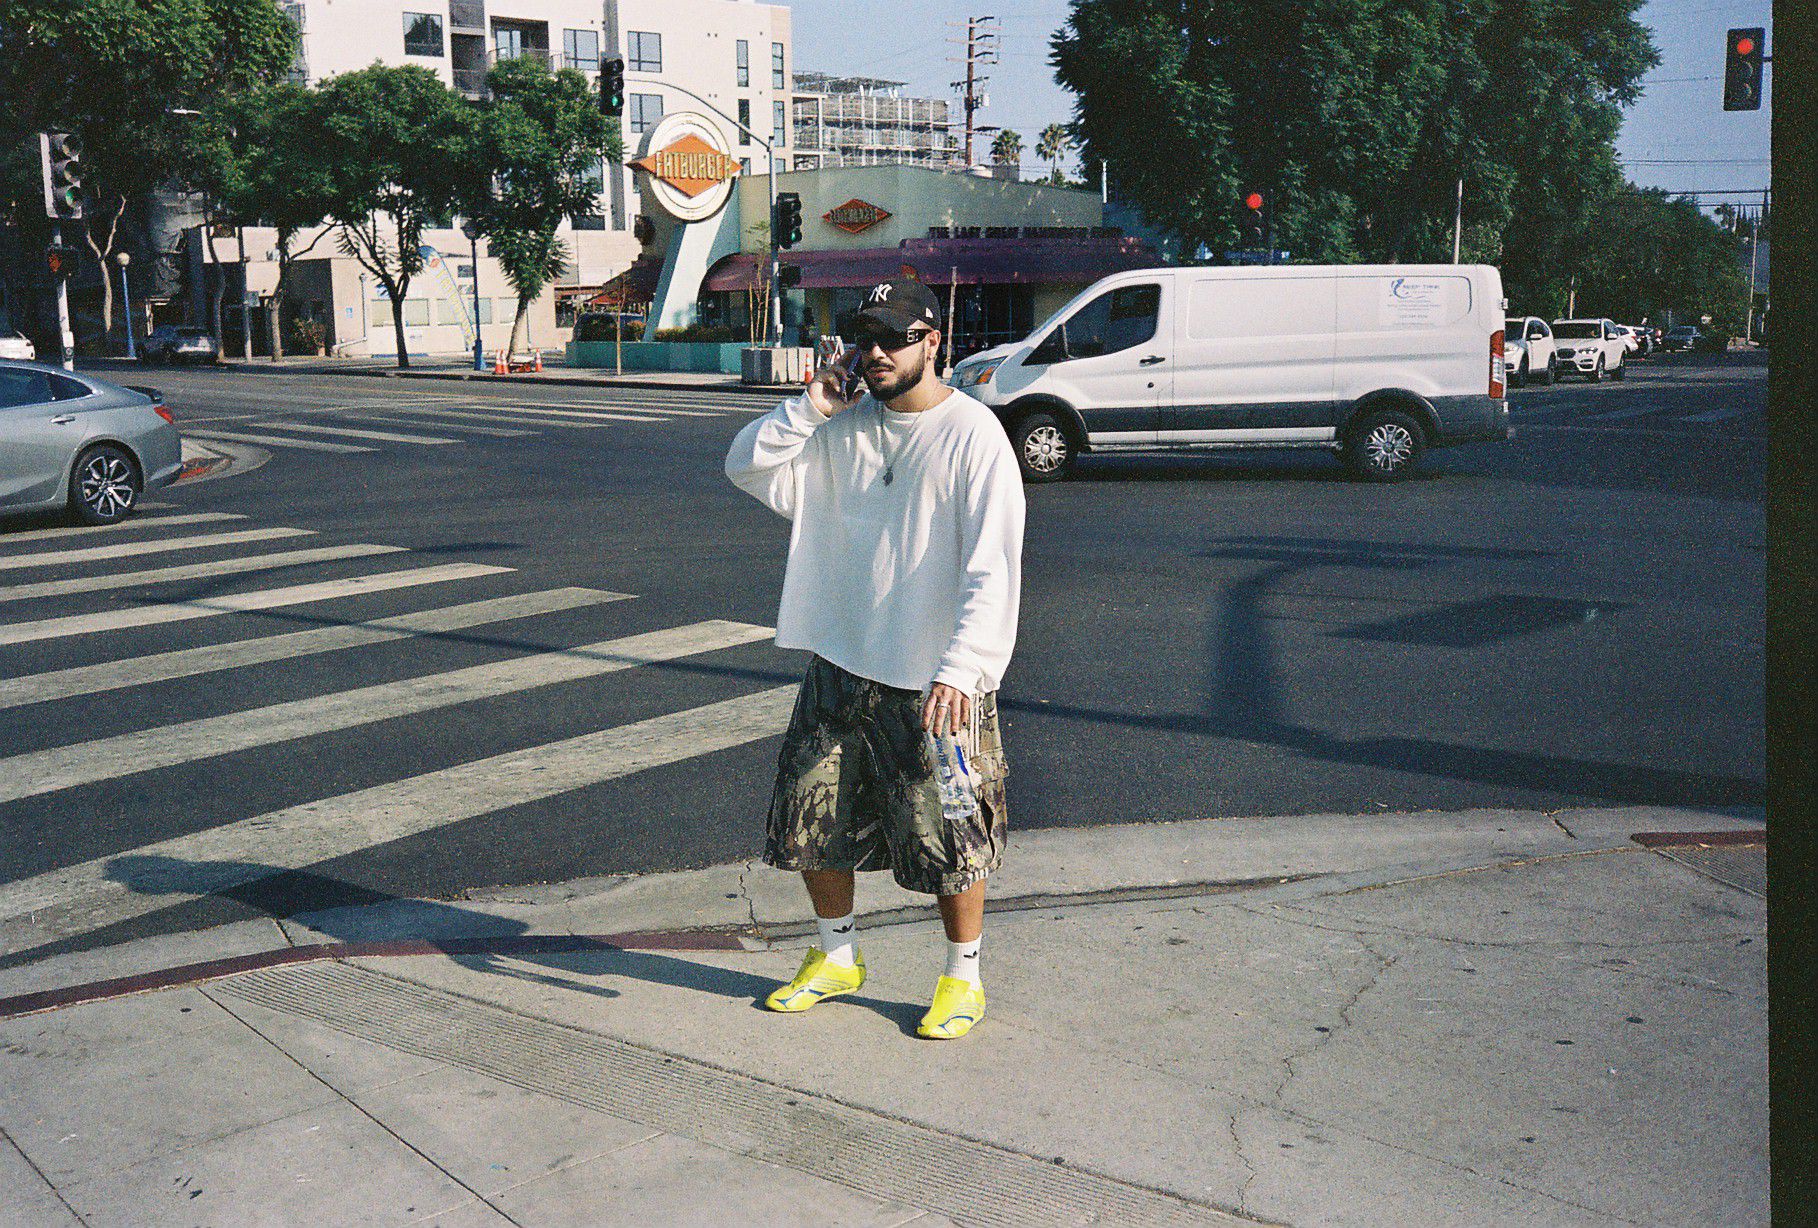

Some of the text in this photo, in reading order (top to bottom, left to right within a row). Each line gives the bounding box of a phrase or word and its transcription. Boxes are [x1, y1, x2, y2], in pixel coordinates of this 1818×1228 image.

[655, 151, 732, 181] FATBURGER
[929, 226, 949, 239] THE
[954, 226, 981, 239] LAST
[869, 283, 893, 303] NY
